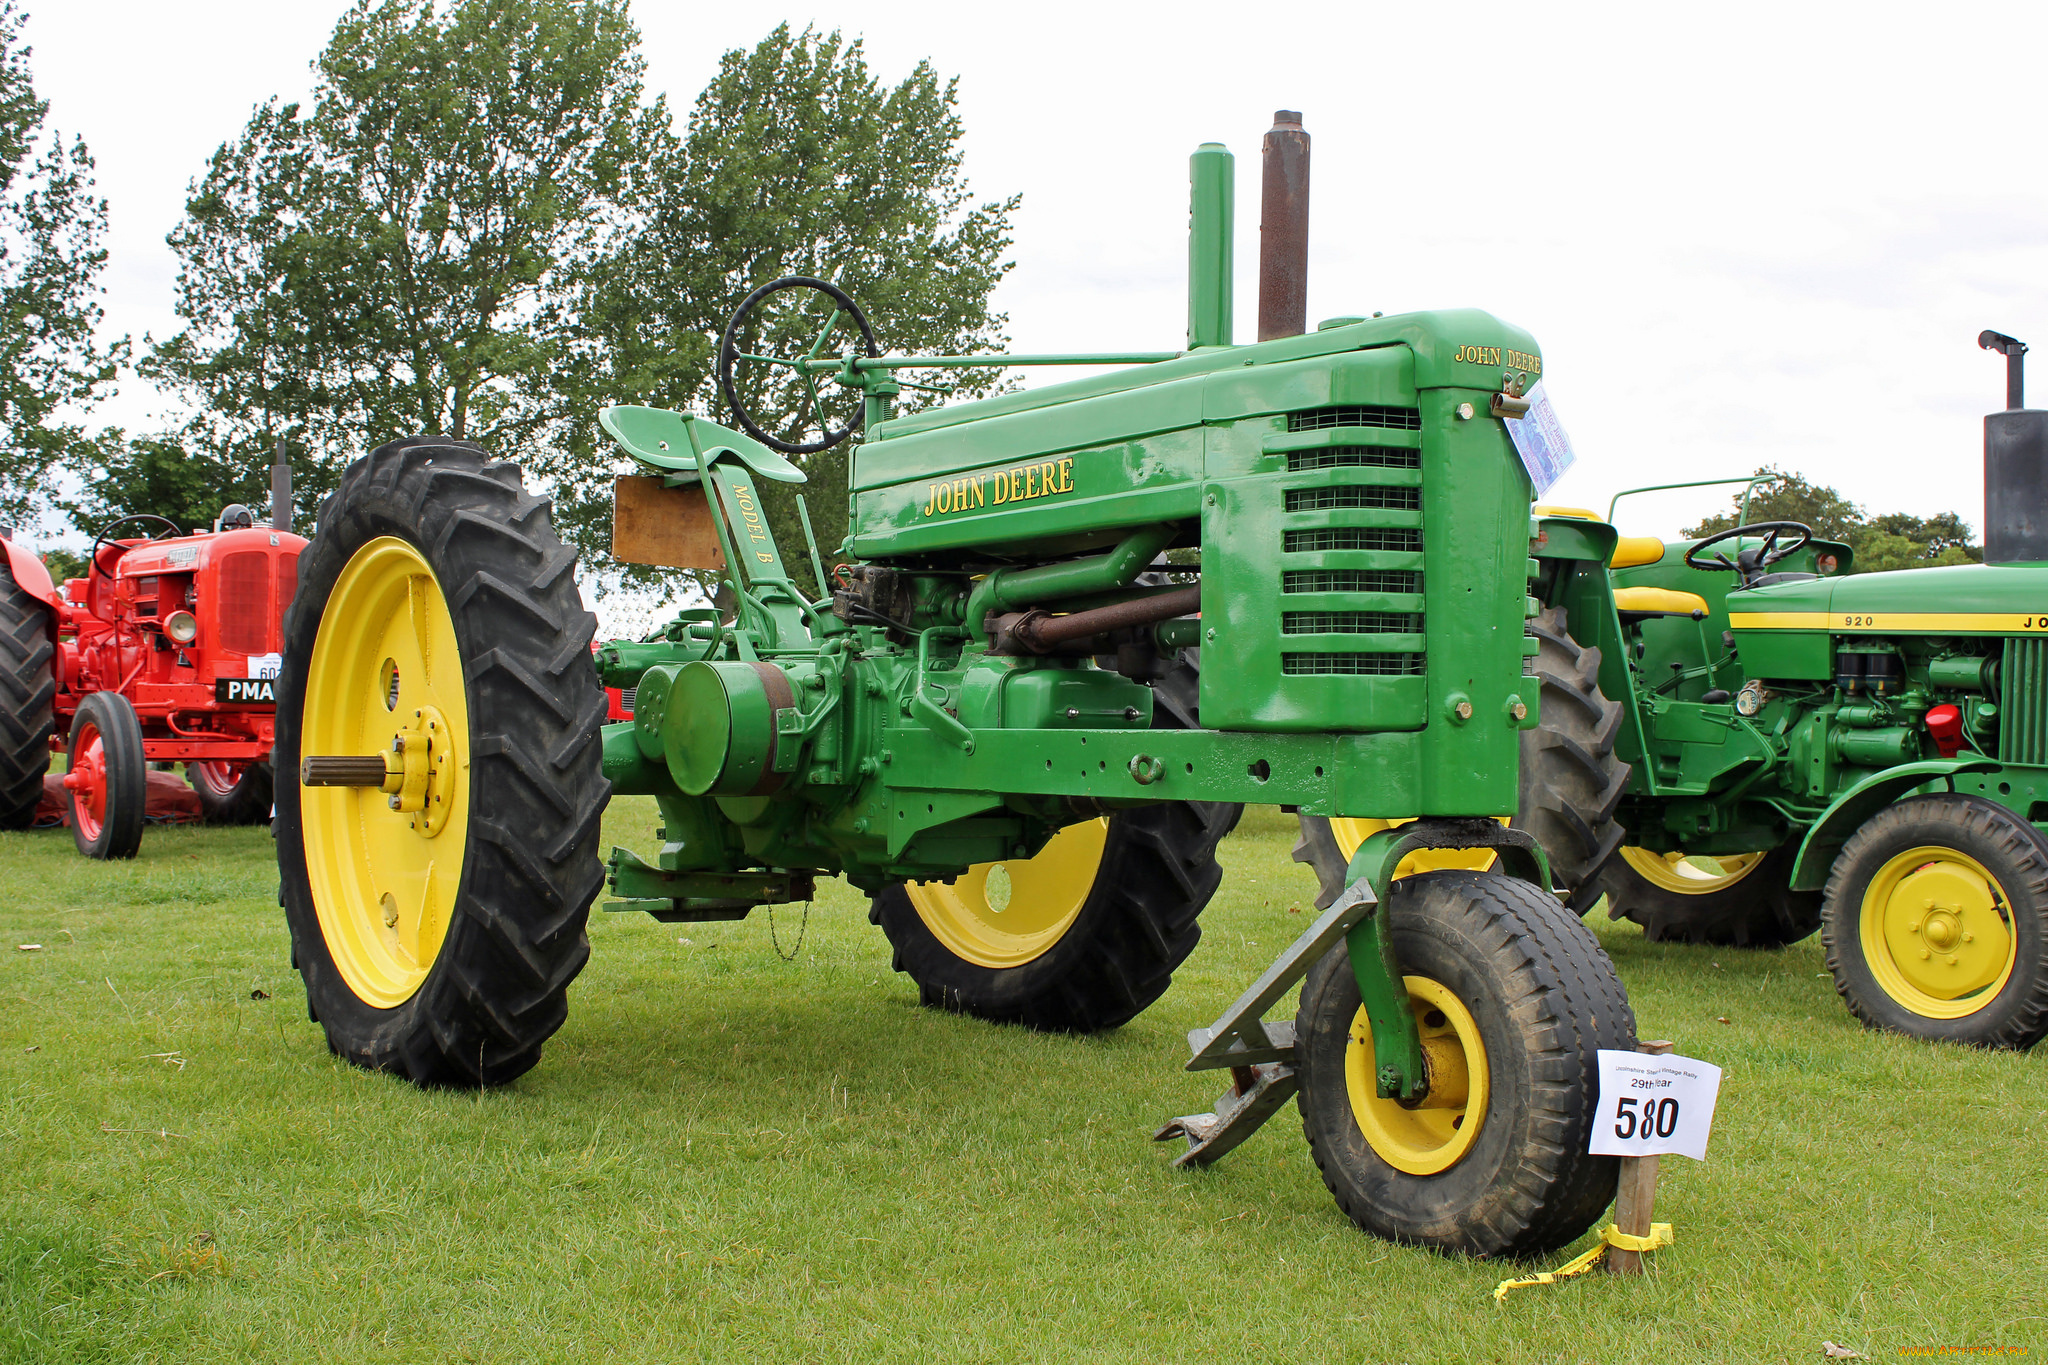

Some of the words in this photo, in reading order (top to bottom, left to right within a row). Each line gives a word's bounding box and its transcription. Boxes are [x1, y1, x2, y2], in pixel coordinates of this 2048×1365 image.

[1455, 345, 1501, 366] JOHN
[1506, 349, 1541, 374] DEERE
[924, 474, 986, 517] JOHN
[992, 457, 1074, 505] DEERE
[732, 483, 767, 544] MODEL
[755, 550, 774, 564] B
[1845, 616, 1873, 627] 920
[228, 681, 275, 700] PMA
[1631, 1078, 1655, 1089] 29th
[1683, 1071, 1697, 1079] Rally
[1614, 1096, 1680, 1140] 580
